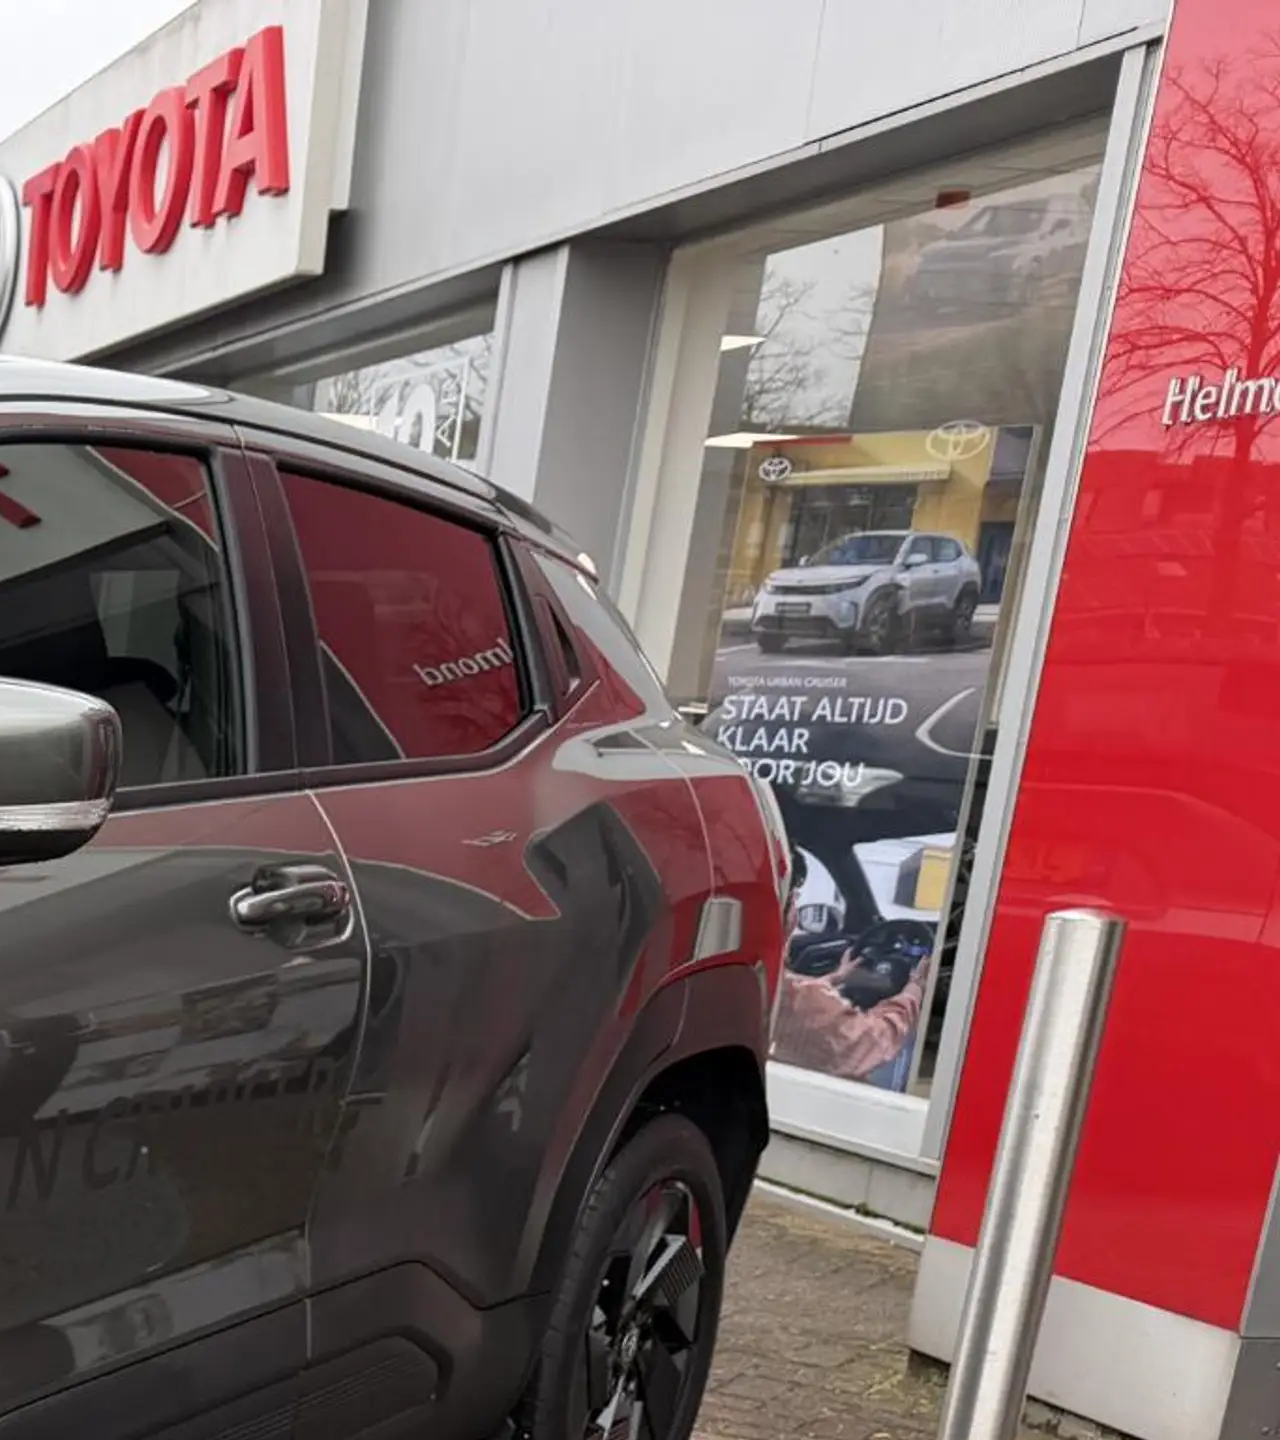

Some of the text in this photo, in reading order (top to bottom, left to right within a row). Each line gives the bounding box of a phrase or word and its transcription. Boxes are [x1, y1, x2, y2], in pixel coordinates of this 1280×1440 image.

[22, 25, 290, 308] TOYOTA
[727, 675, 848, 689] TOYOTA URBAN CRUISER
[720, 694, 909, 725] STAAT ALTIJD
[717, 725, 810, 754] KLAAR
[801, 760, 867, 788] JOU
